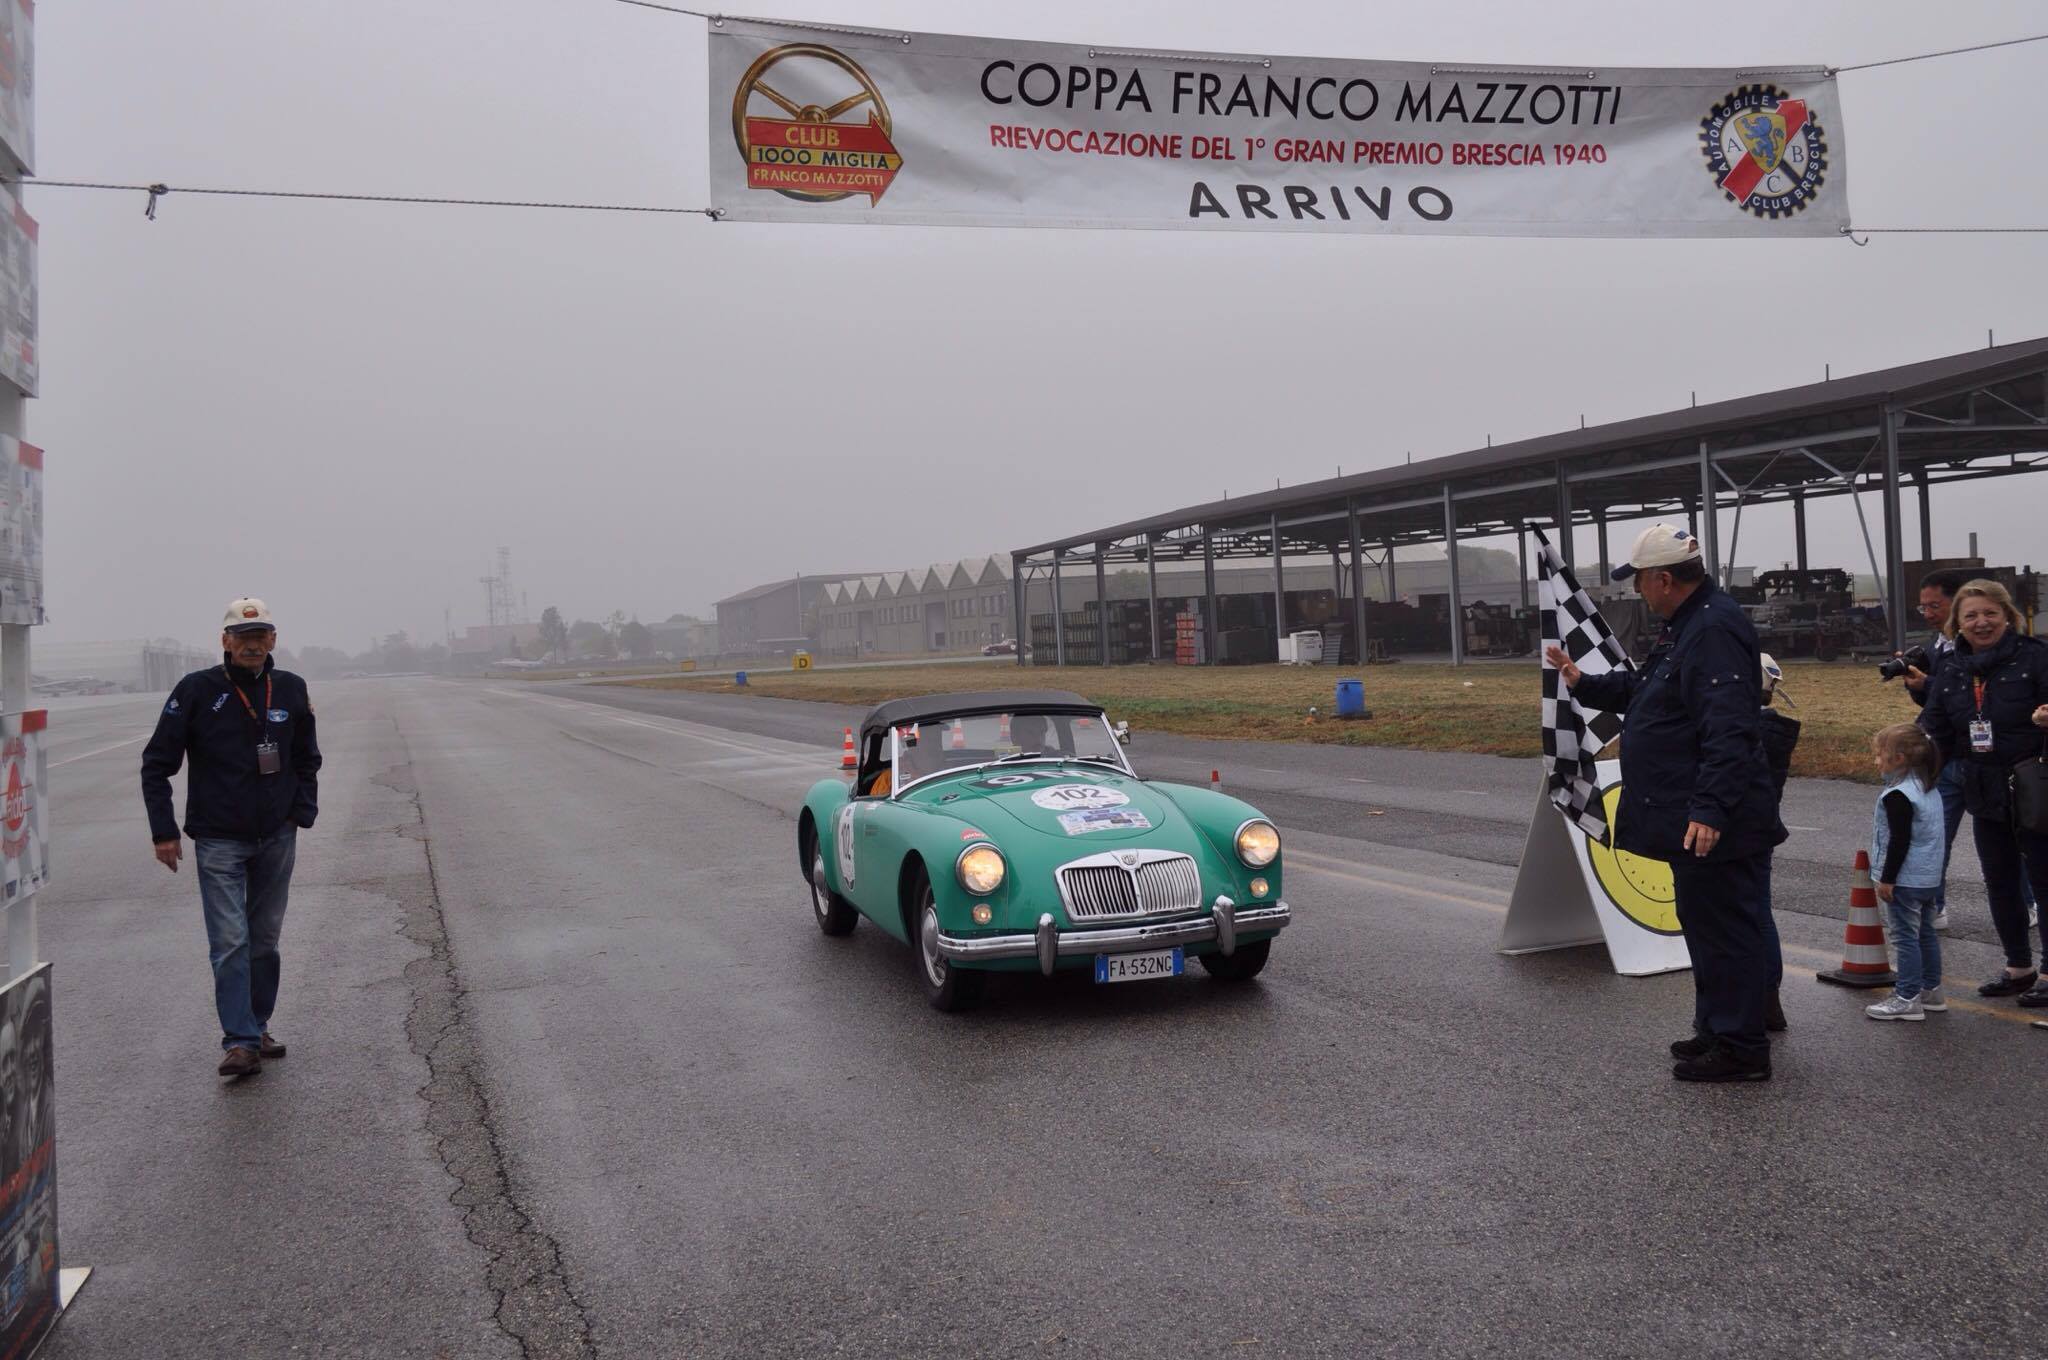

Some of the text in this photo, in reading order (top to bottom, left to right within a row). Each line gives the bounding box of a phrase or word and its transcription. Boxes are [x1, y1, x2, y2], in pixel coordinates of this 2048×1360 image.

[980, 60, 1622, 125] COPPA FRANCO MAZZOTTI
[784, 126, 841, 146] CLUB
[1710, 95, 1769, 171] AUTOMOBILE
[990, 124, 1607, 166] RIEVOCAZIONE DEL 1° GRAN PREMIO BRESCIA 1940
[1727, 137, 1741, 152] A
[1791, 145, 1804, 163] B
[758, 147, 889, 169] 1000 MIGLIA
[1794, 131, 1820, 199] BRESCIA
[753, 168, 884, 186] FRANCO MAZZOTTI
[1766, 175, 1782, 194] C
[1189, 181, 1454, 222] ARRIVO
[1752, 196, 1791, 209] CLUB
[1051, 788, 1108, 801] 102
